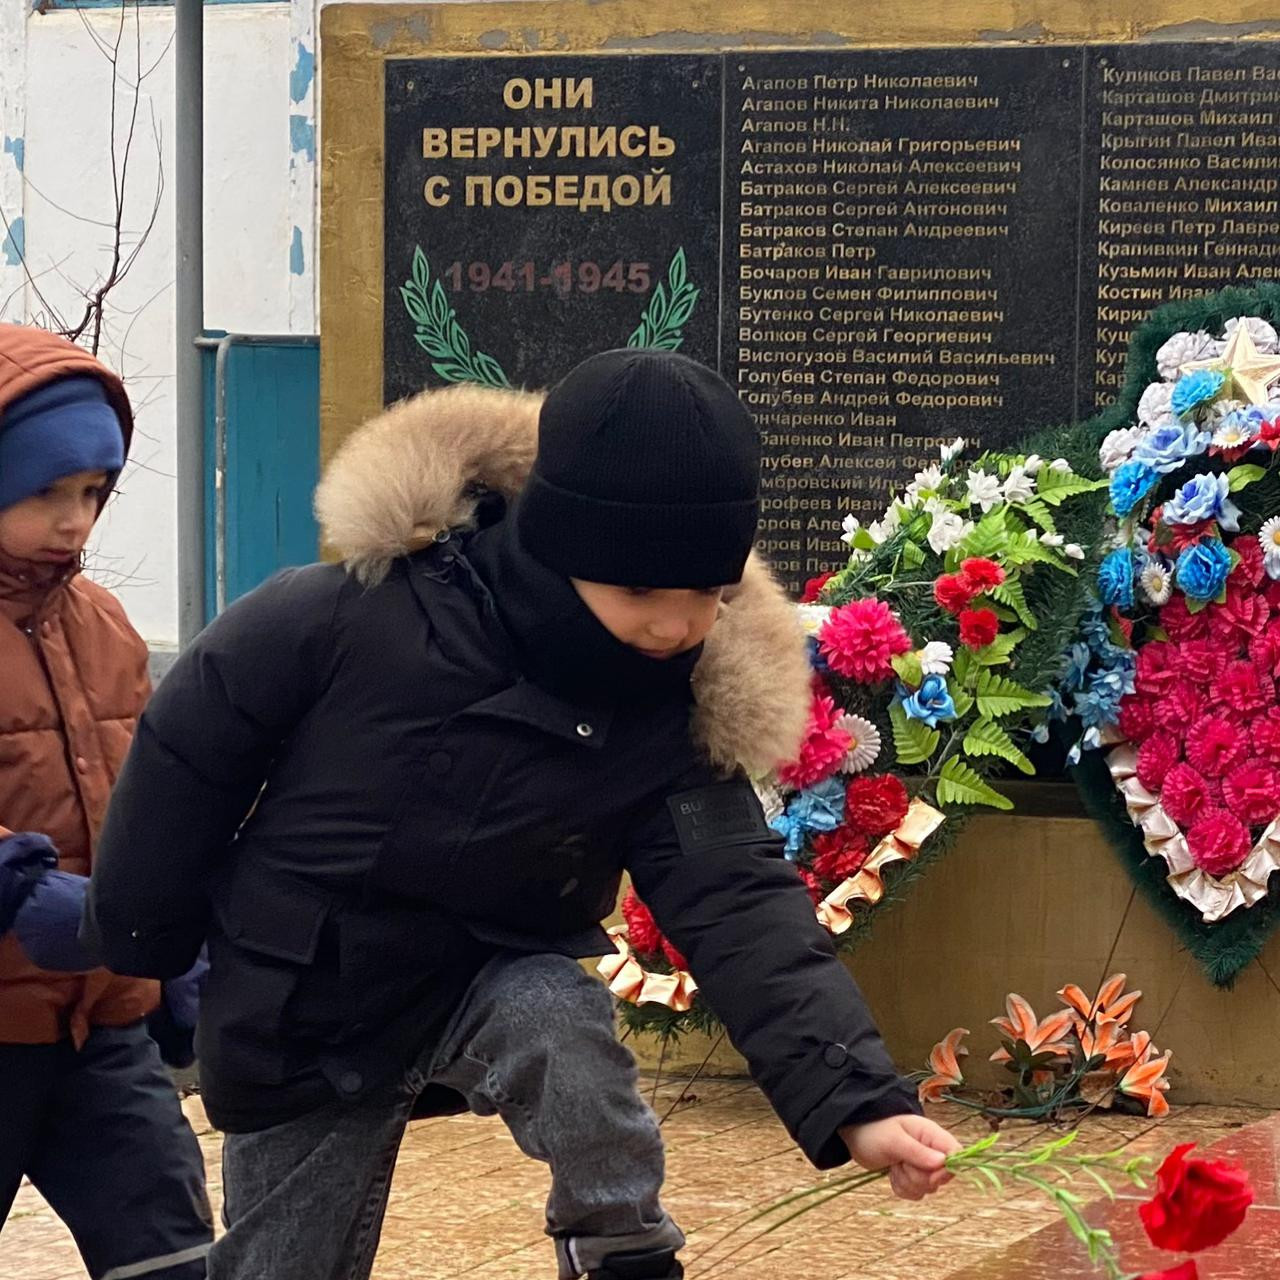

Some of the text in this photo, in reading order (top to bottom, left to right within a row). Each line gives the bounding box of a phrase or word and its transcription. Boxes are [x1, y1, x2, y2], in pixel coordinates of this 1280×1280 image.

[742, 74, 978, 92] Агапов Петр Николаевич
[1103, 68, 1181, 85] Куликов
[1187, 66, 1246, 82] Павел
[503, 77, 593, 109] ОНИ
[741, 116, 850, 135] Агапов Н.Н.
[423, 125, 675, 159] ВЕРНУЛИСЬ
[741, 134, 1021, 155] Агапов Николай Григорьевич
[1100, 155, 1201, 170] Колосянко
[424, 166, 671, 212] С ПОБЕДОЙ
[740, 201, 1007, 219] Батраков Сергей Антонович
[1099, 198, 1199, 213] Коваленко
[1205, 198, 1278, 213] Михаил
[444, 261, 651, 294] 1941-1945
[1098, 263, 1177, 281] Кузьмин
[1184, 263, 1230, 278] Иван
[739, 306, 1004, 325] Бутенко Сергей Николаевич
[739, 348, 1055, 367] Вислогузов Василий Васильевич
[738, 368, 999, 388] Голубев Степан Федорович
